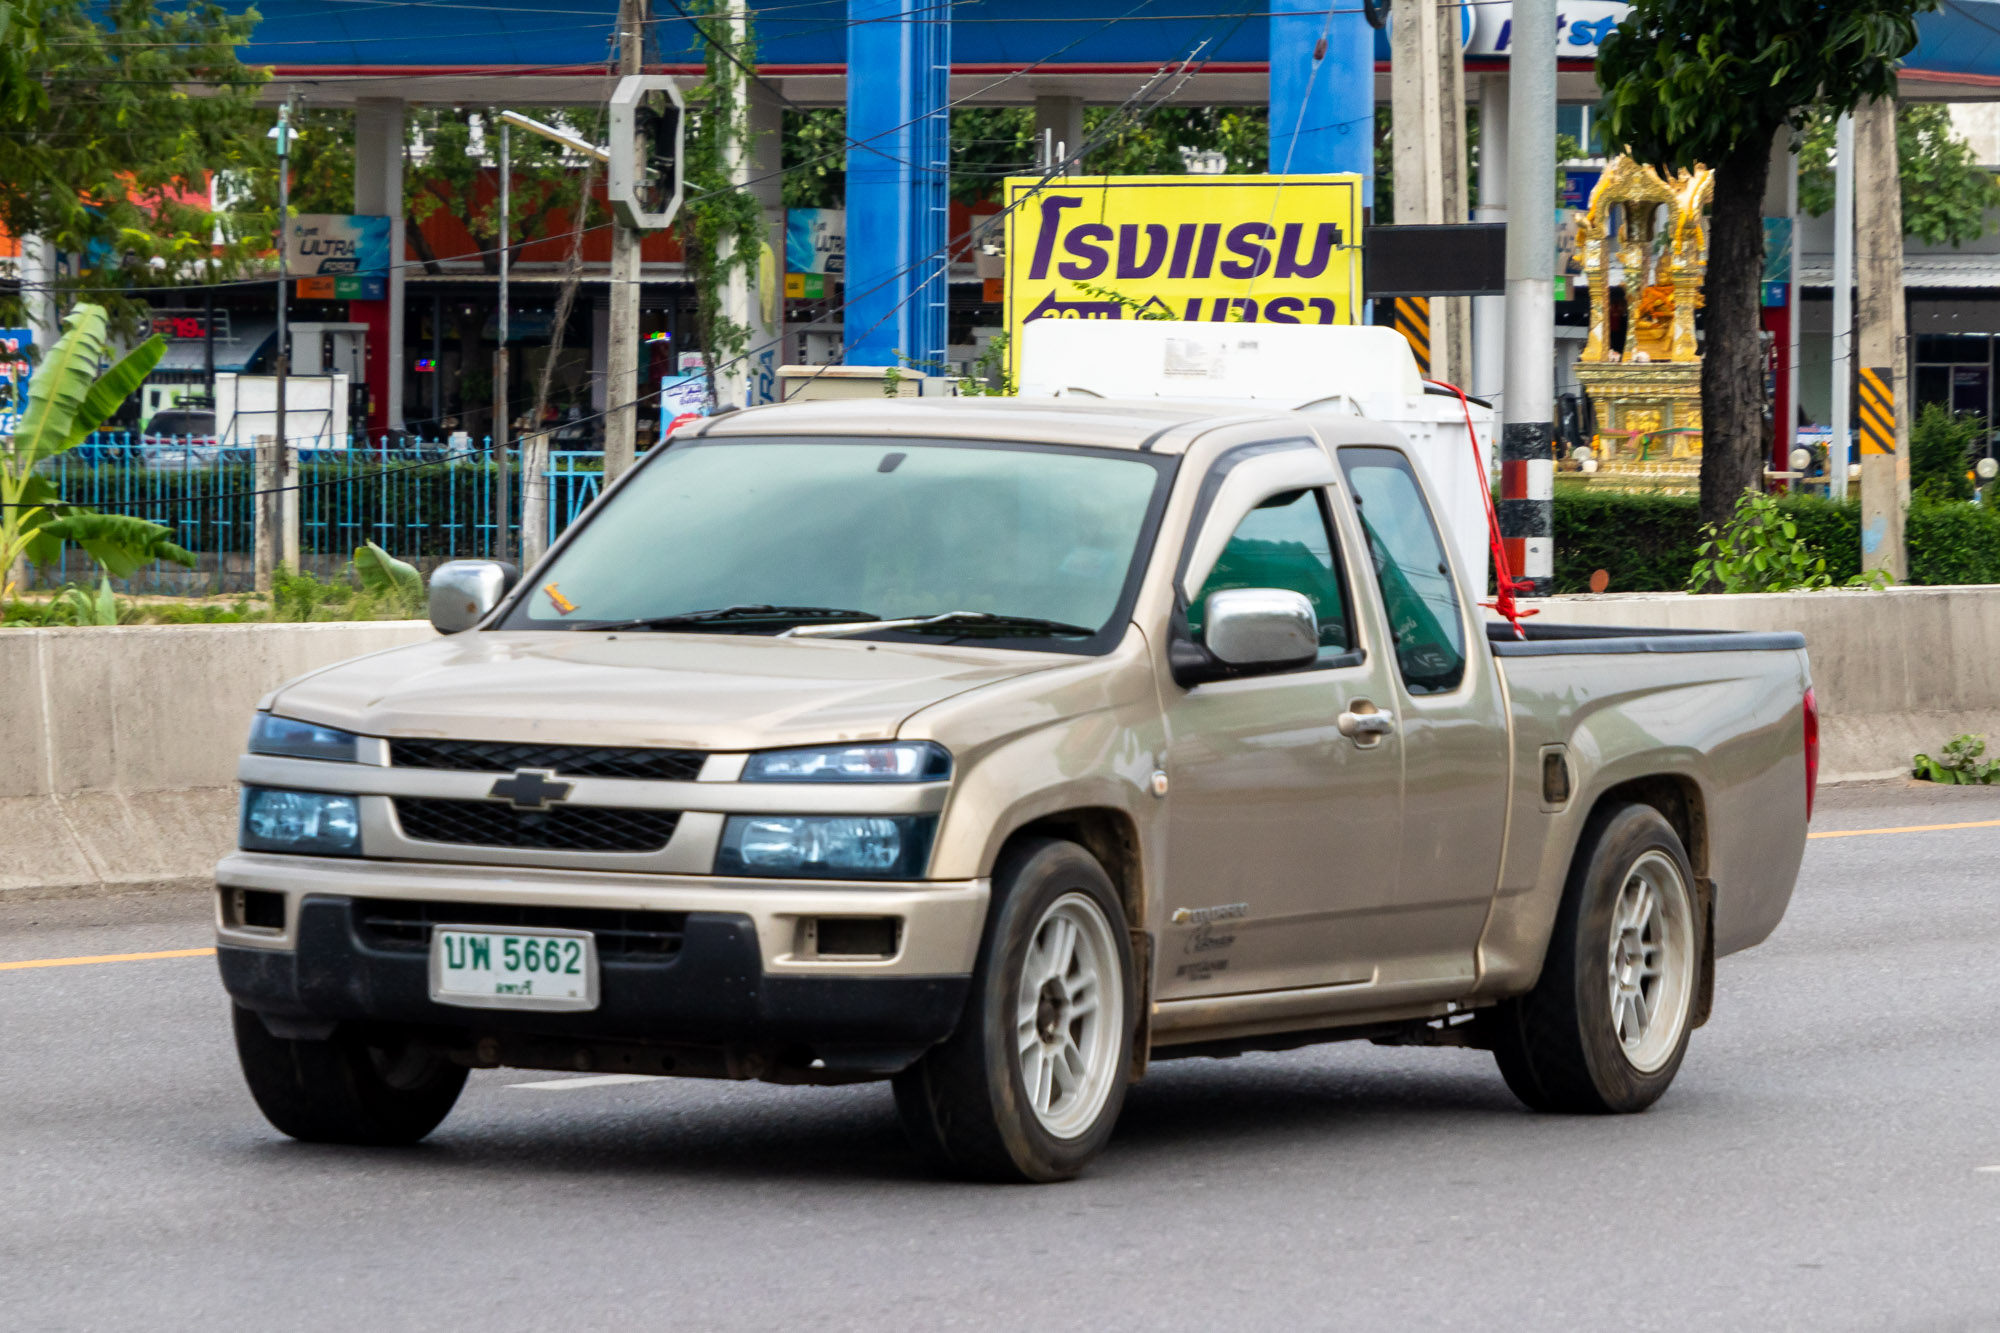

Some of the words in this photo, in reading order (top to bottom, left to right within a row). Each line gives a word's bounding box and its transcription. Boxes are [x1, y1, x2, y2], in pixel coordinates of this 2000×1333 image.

[300, 239, 356, 256] ULTRA
[1028, 194, 1338, 281] โรงแรม
[504, 937, 581, 974] 5662
